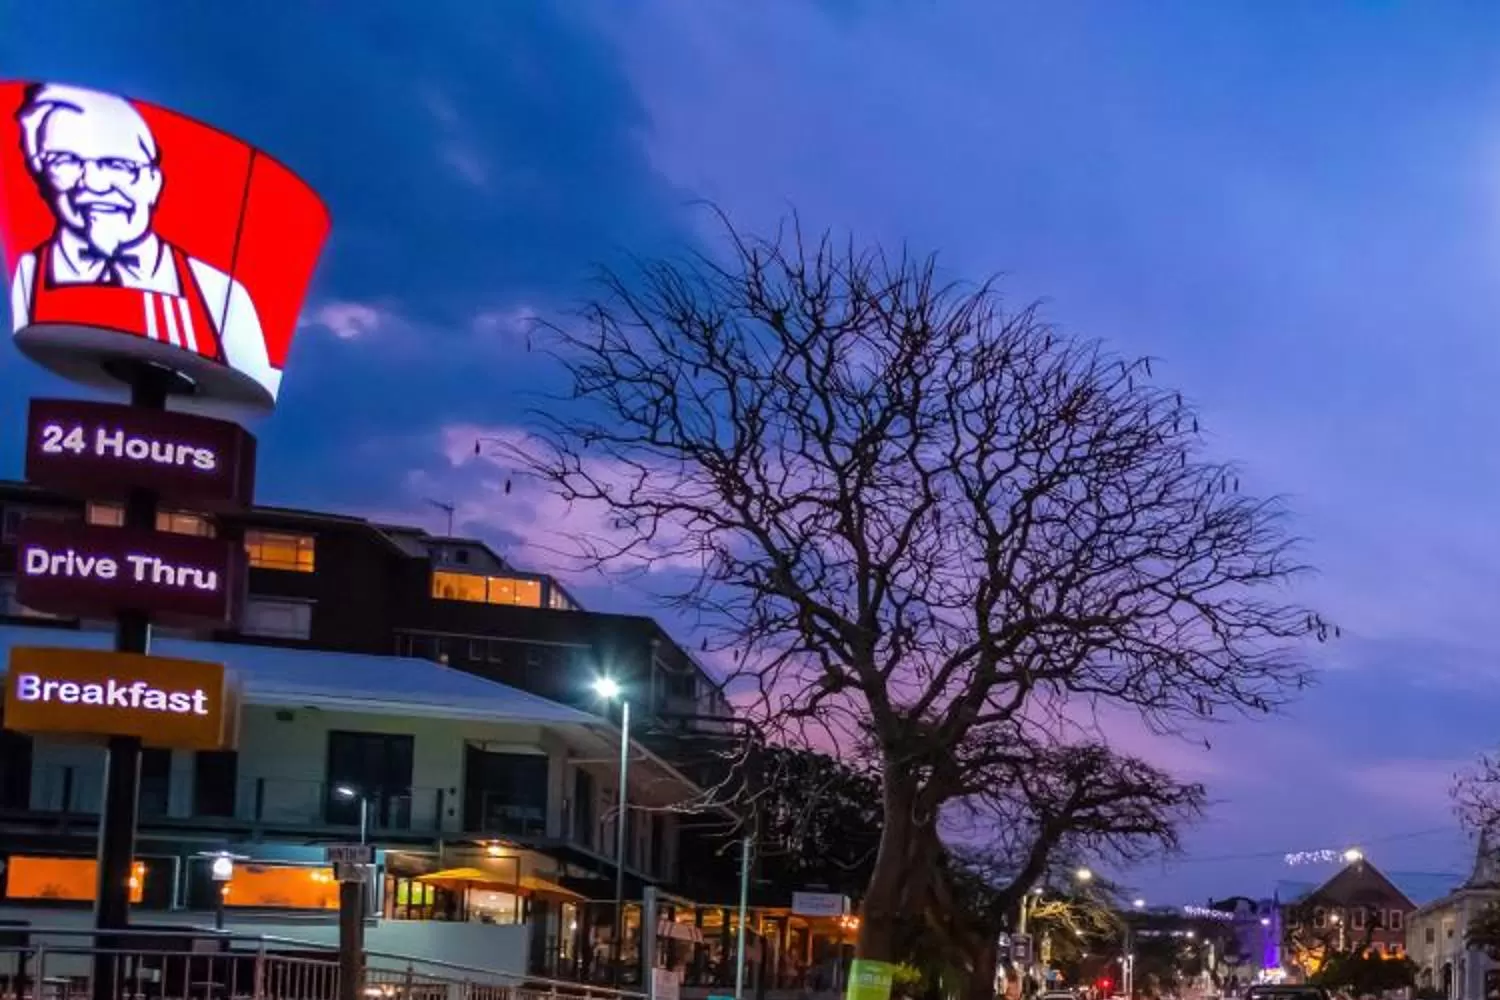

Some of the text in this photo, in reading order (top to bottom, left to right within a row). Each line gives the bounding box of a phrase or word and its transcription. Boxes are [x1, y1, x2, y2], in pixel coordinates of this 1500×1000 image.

[42, 425, 216, 470] 24 Hours
[26, 548, 217, 591] Drive Thru
[17, 674, 209, 716] Breakfast
